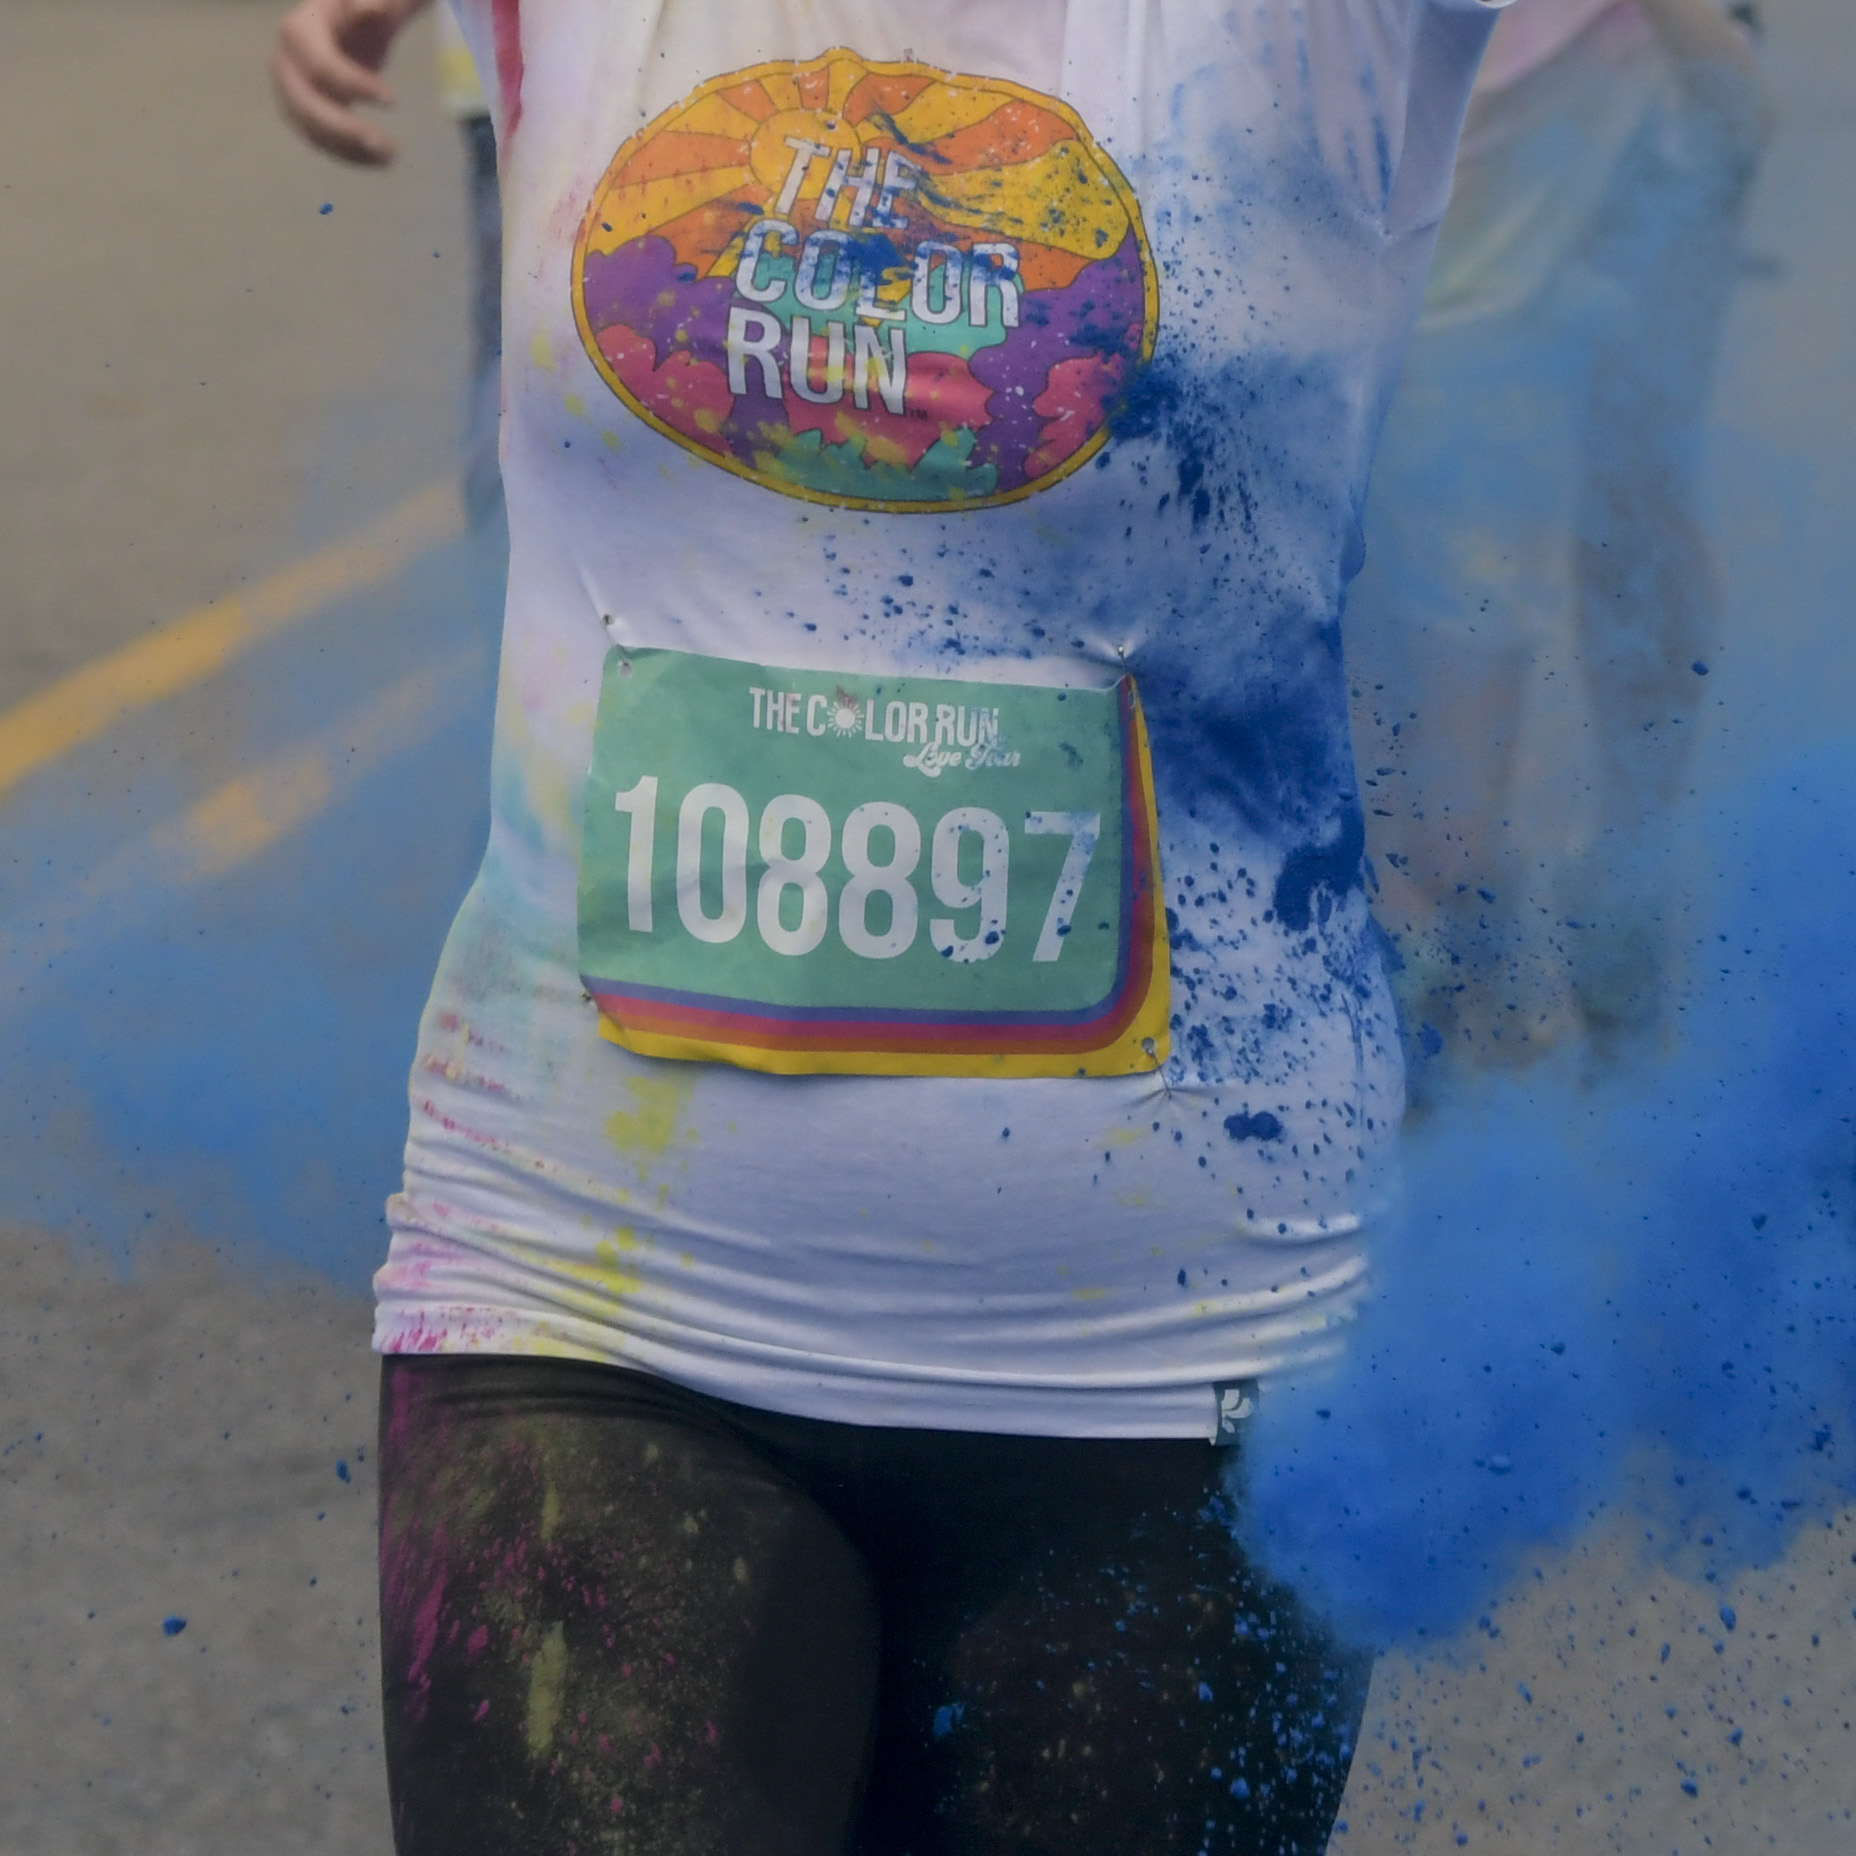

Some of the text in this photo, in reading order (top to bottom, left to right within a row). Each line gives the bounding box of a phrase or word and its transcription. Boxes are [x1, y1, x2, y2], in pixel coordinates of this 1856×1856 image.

[772, 136, 919, 230] THE
[735, 218, 1020, 328] COLOR
[725, 305, 909, 415] RUN
[749, 686, 802, 734] THE
[934, 703, 999, 747] RUN
[903, 741, 962, 778] Love
[614, 774, 1101, 963] 108897
